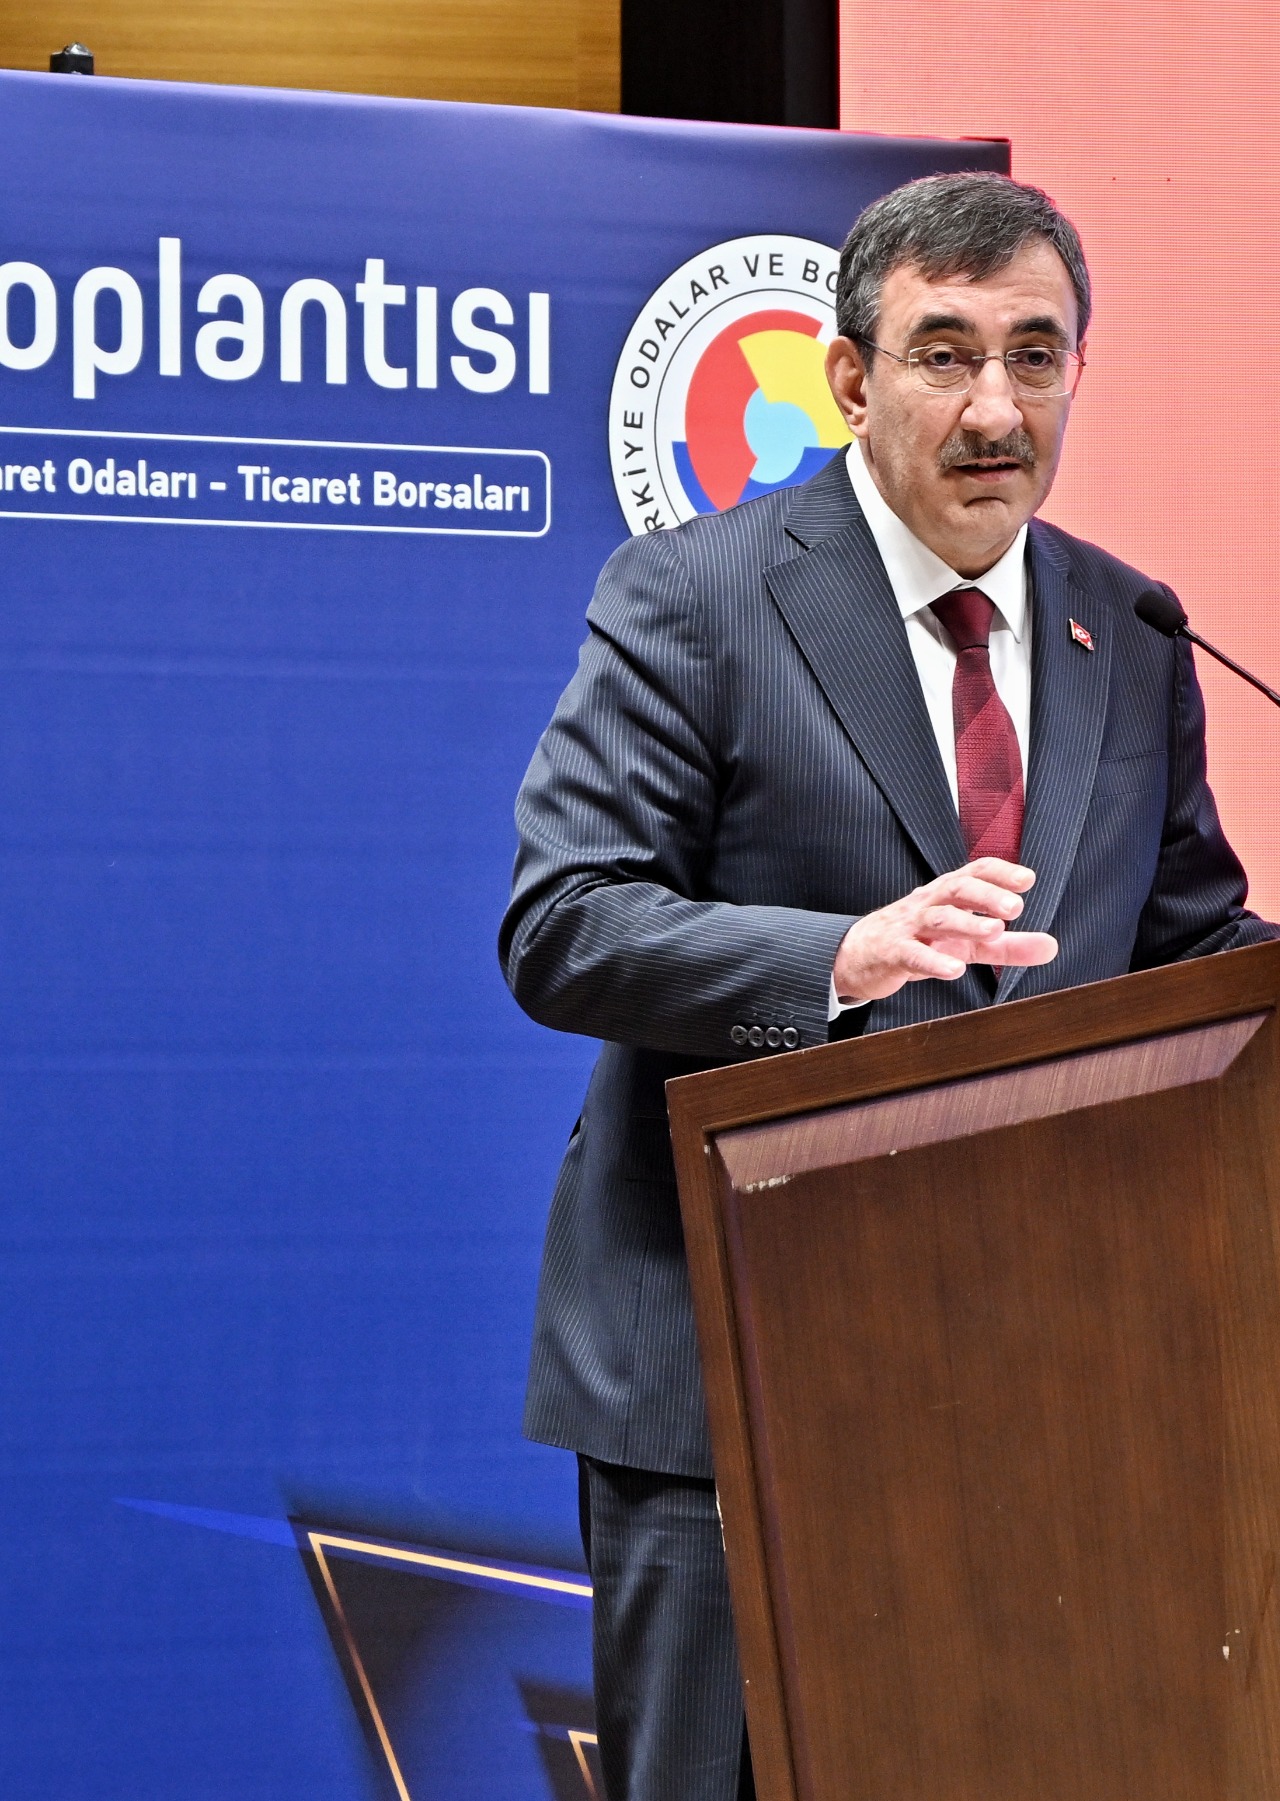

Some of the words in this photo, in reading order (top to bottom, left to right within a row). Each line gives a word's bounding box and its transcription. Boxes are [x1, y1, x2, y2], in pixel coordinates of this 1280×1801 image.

[629, 264, 731, 389] ODALAR
[742, 252, 785, 279] VE
[0, 459, 57, 493] ret
[67, 457, 197, 499] Odaları
[237, 465, 361, 506] Ticaret
[373, 470, 530, 512] Borsaları
